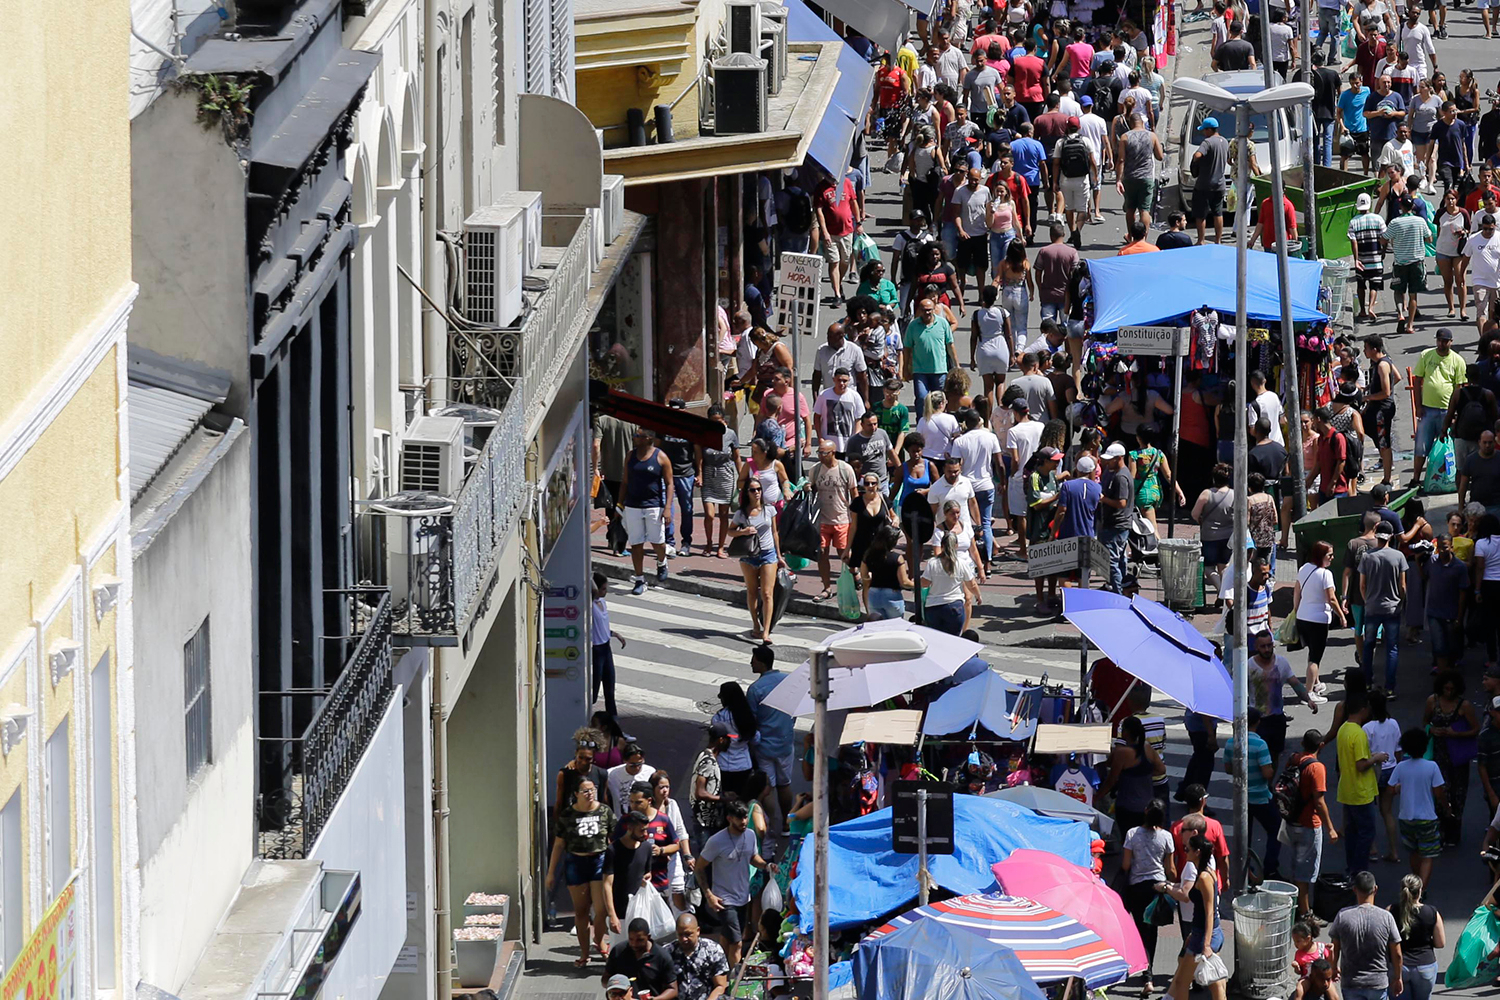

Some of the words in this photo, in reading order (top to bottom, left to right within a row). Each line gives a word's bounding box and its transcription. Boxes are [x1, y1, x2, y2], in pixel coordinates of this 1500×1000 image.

[782, 255, 820, 268] CONSERTO
[794, 265, 806, 273] NA
[1118, 328, 1171, 342] Constituição
[1029, 540, 1077, 560] Constituição
[578, 821, 599, 836] 23
